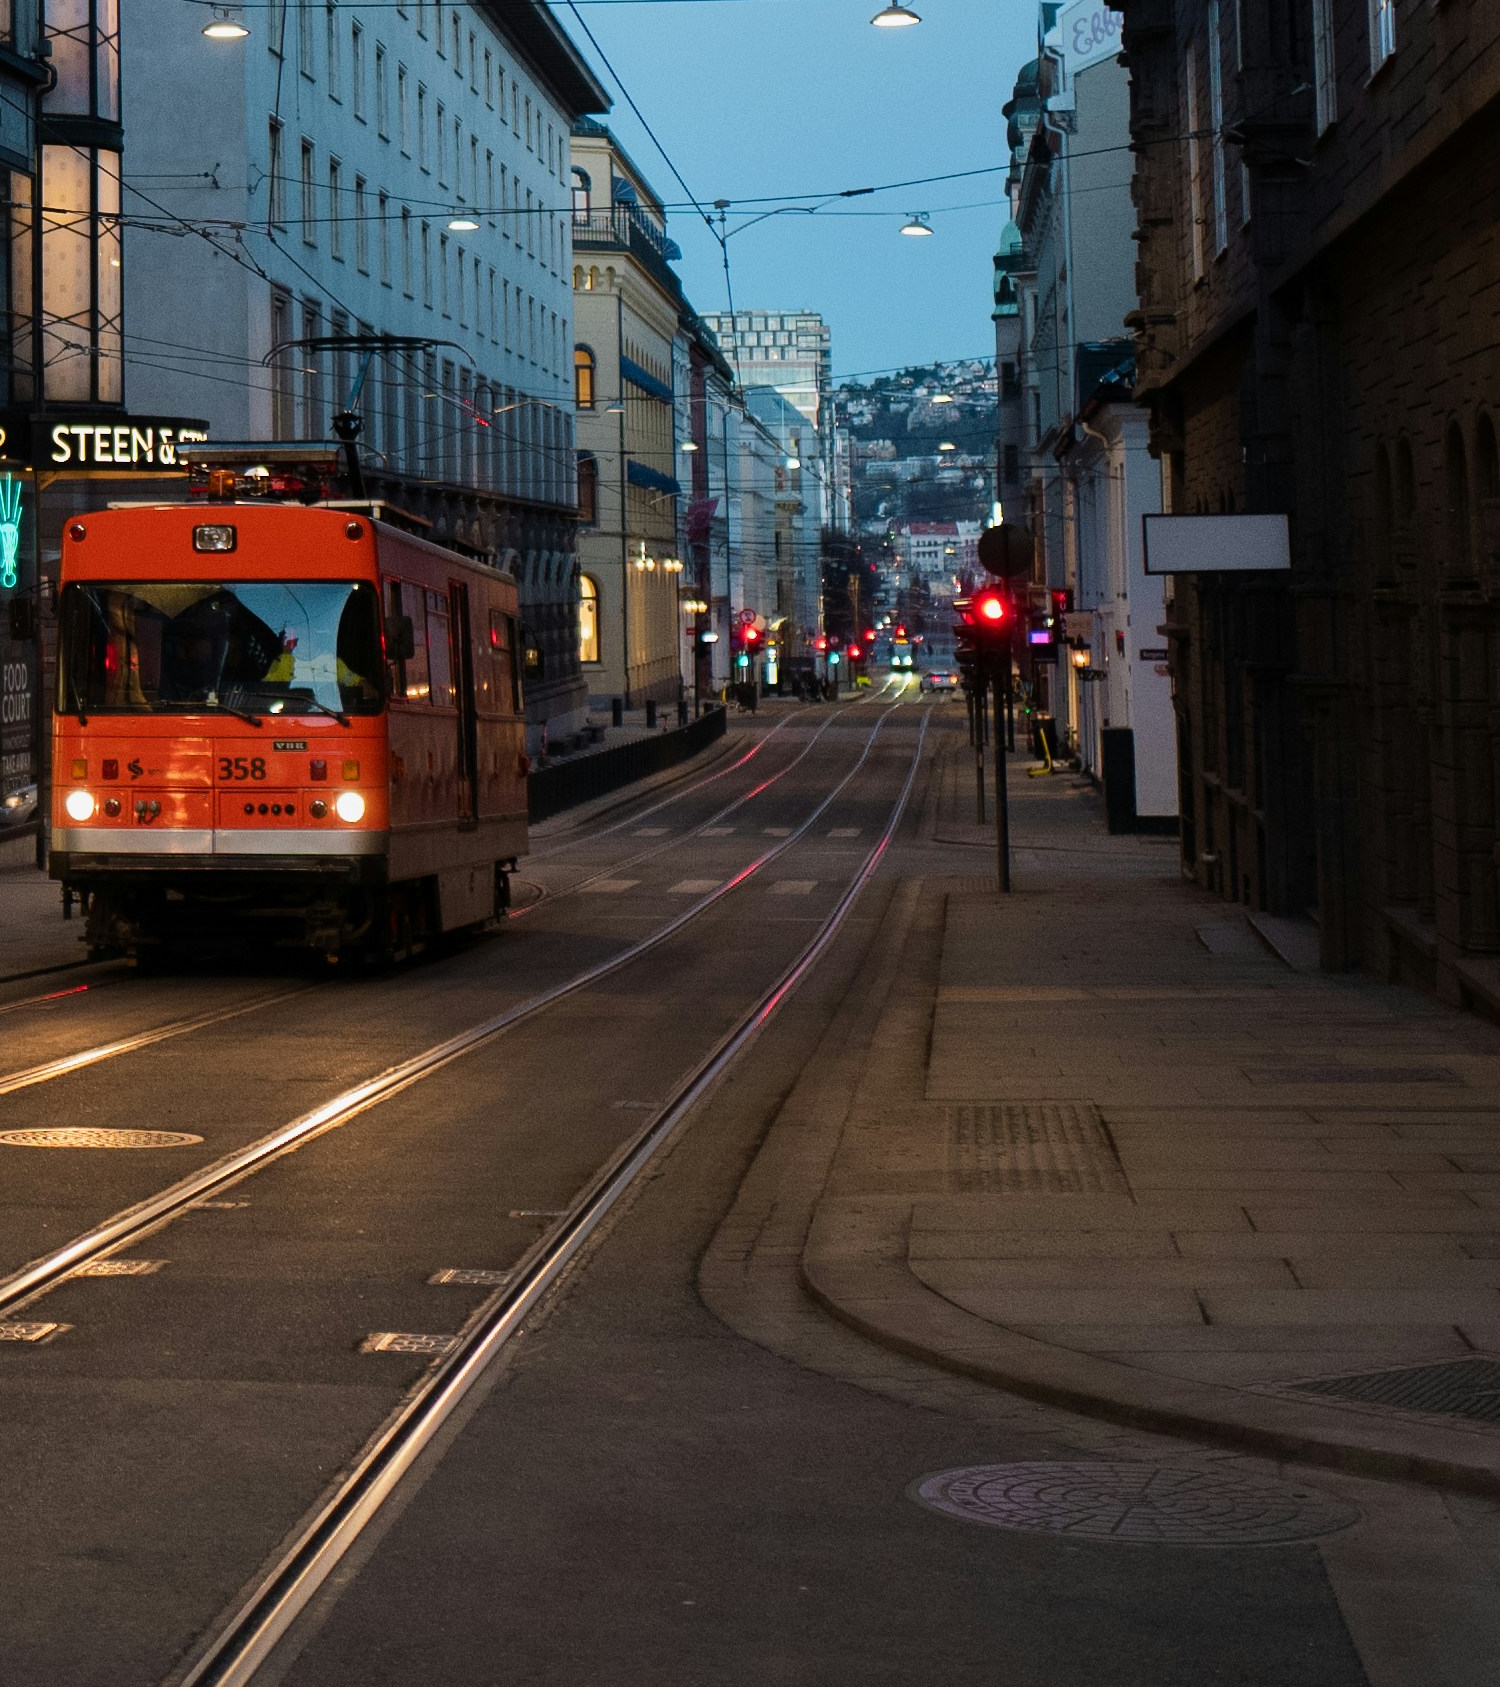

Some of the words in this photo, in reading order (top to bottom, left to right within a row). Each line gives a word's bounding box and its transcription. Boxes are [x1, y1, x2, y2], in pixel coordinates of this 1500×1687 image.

[51, 424, 155, 463] STEEN
[159, 427, 177, 465] &
[3, 663, 28, 693] FOOD
[2, 692, 31, 723] COURT
[218, 757, 266, 781] 358
